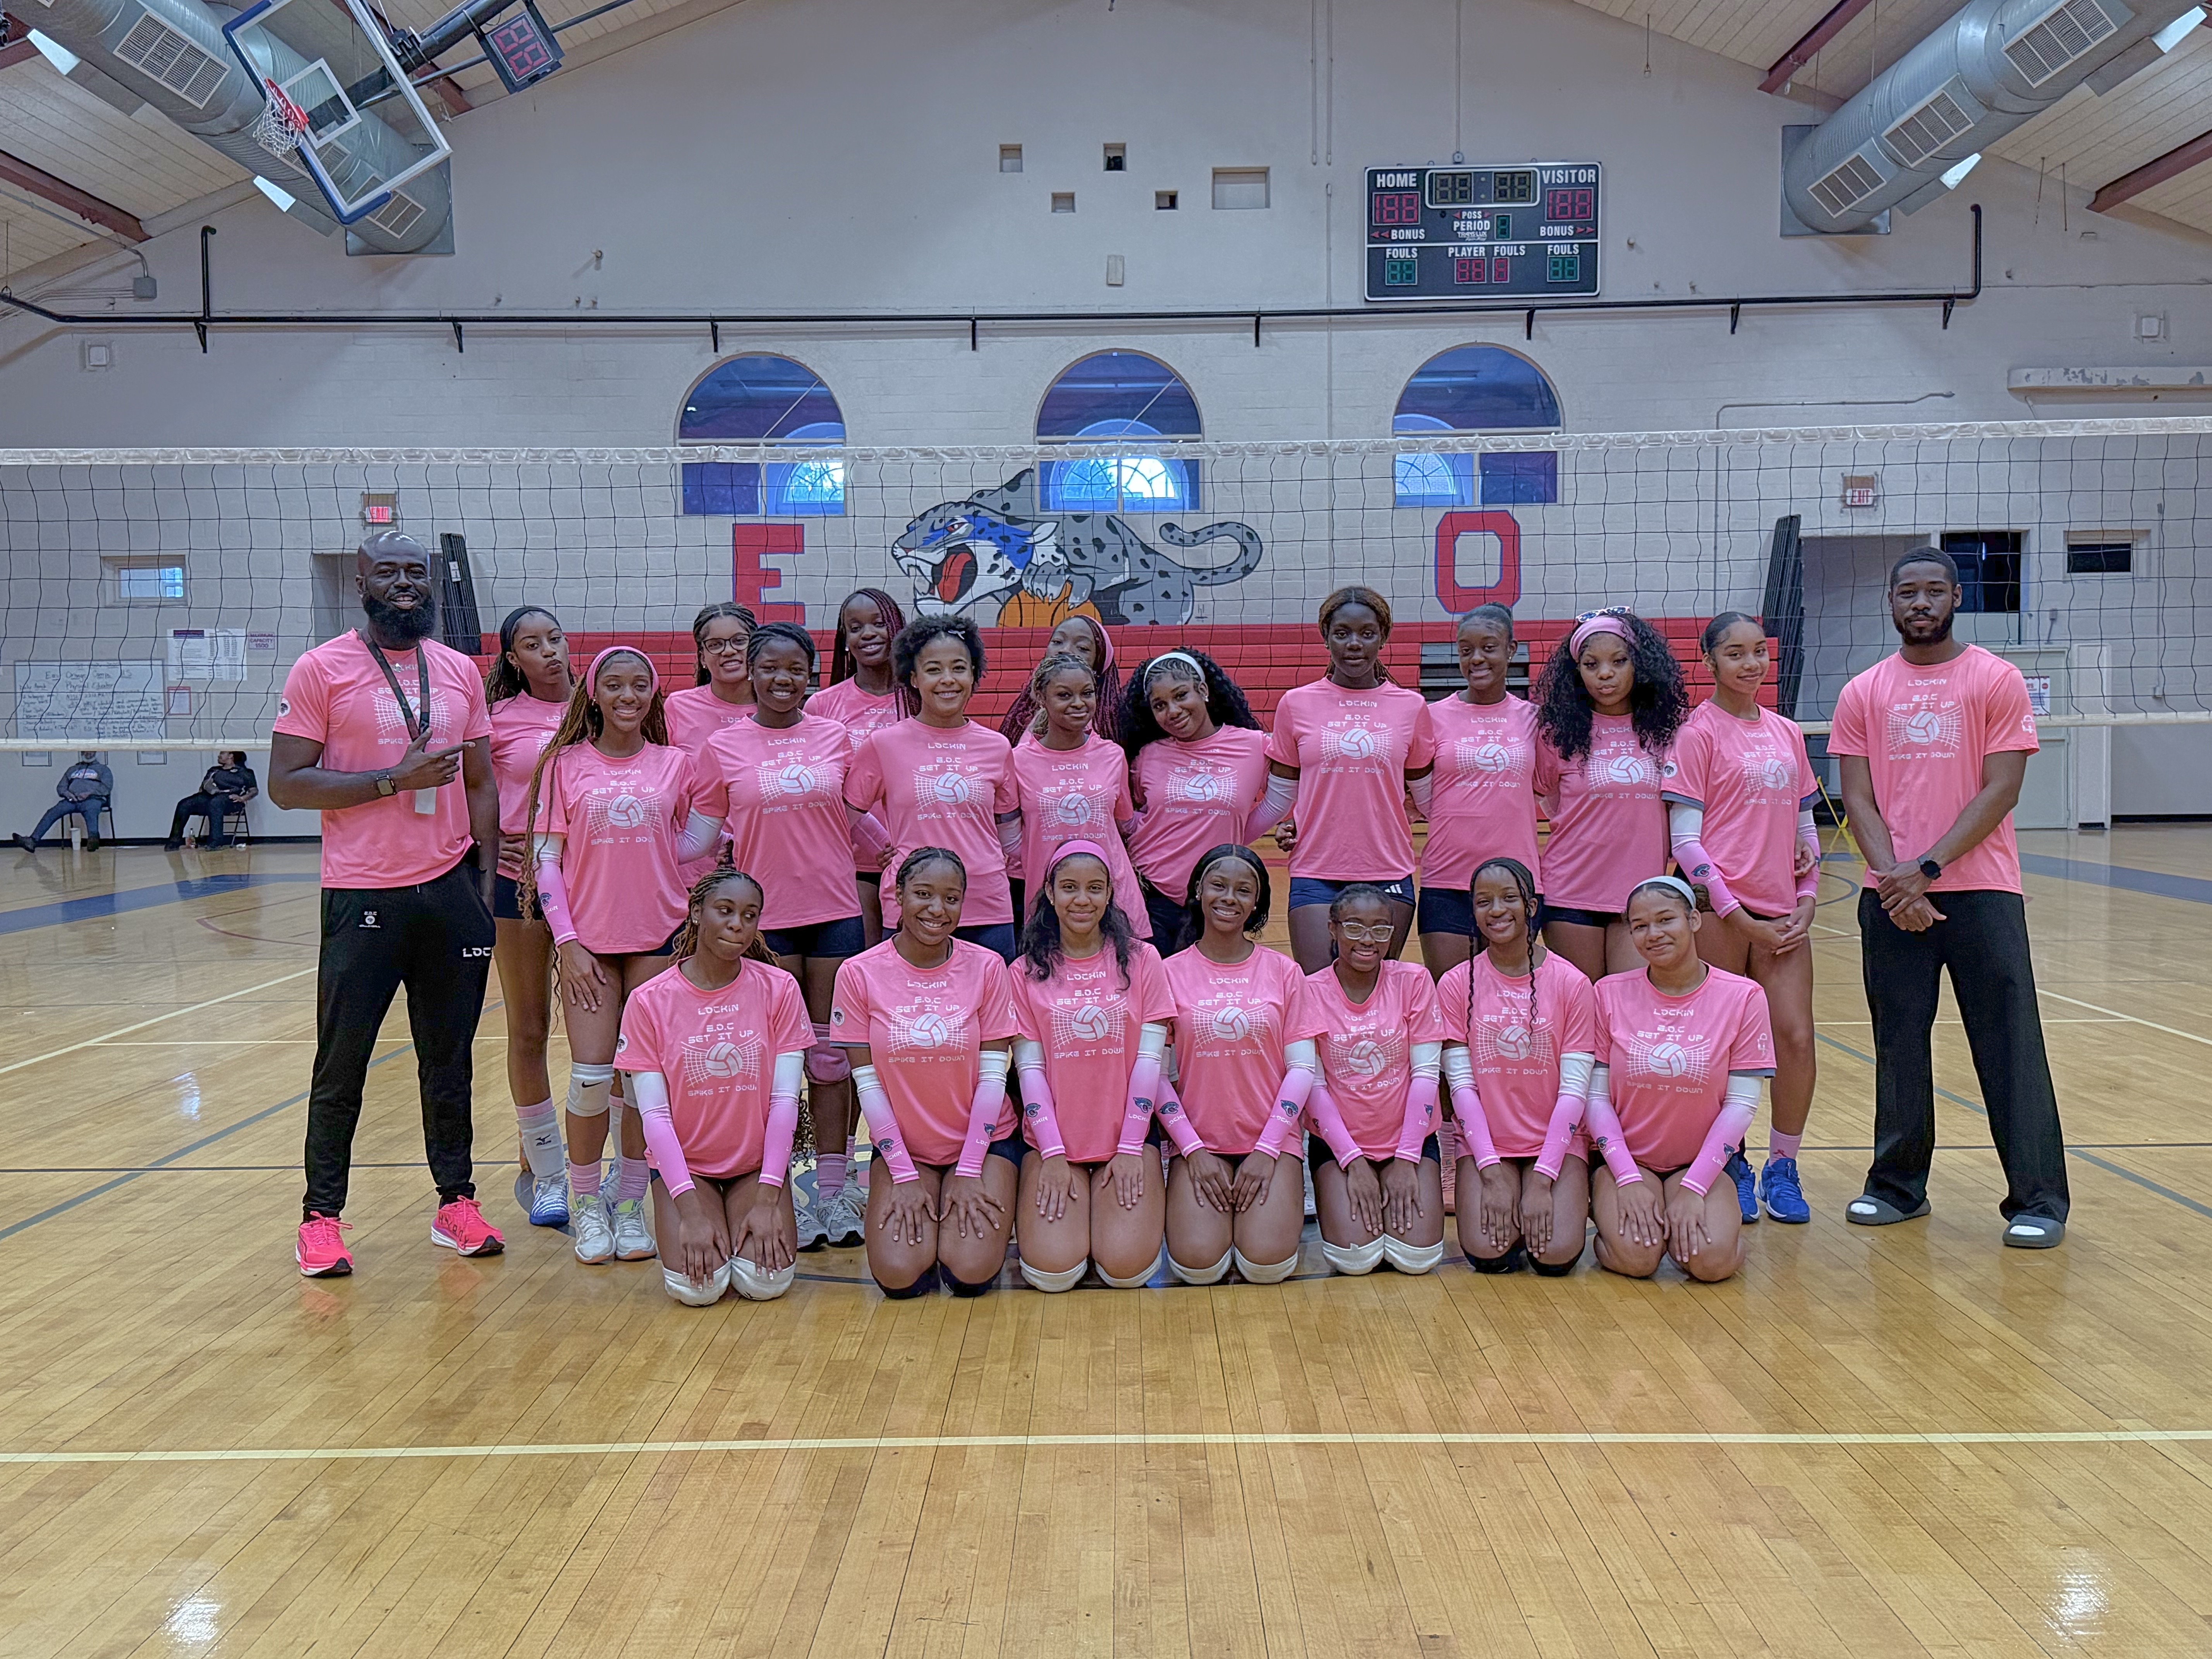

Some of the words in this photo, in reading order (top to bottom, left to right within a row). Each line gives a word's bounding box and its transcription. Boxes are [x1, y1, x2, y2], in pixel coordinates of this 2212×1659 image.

[1376, 173, 1417, 187] HOME
[1542, 169, 1596, 184] VISITOR
[1453, 221, 1490, 231] PERIOD
[1539, 225, 1574, 236] BONUS
[1391, 229, 1425, 240] BONUS
[1386, 248, 1417, 258] FOULS
[1448, 247, 1485, 257] PLAYER
[1494, 246, 1525, 256] FOULS
[1547, 245, 1579, 255] FOULS
[1434, 510, 1521, 615] O
[732, 524, 805, 626] E
[768, 738, 806, 746] LOCKIN
[778, 750, 804, 758] E.O.C
[763, 805, 787, 814] SPIKE
[462, 947, 491, 957] LOC
[1067, 971, 1106, 981] LOCKIN
[907, 980, 946, 989] LOCKIN
[1075, 988, 1101, 996] E.O.C
[698, 1004, 739, 1015] LOCKIN
[1653, 1008, 1693, 1017] LOCKIN
[706, 1022, 734, 1032] E.O.C
[1350, 1023, 1376, 1032] E.O.C
[688, 1034, 711, 1044] SET
[1637, 1030, 1660, 1039] SET
[1377, 1077, 1400, 1087] DOWN
